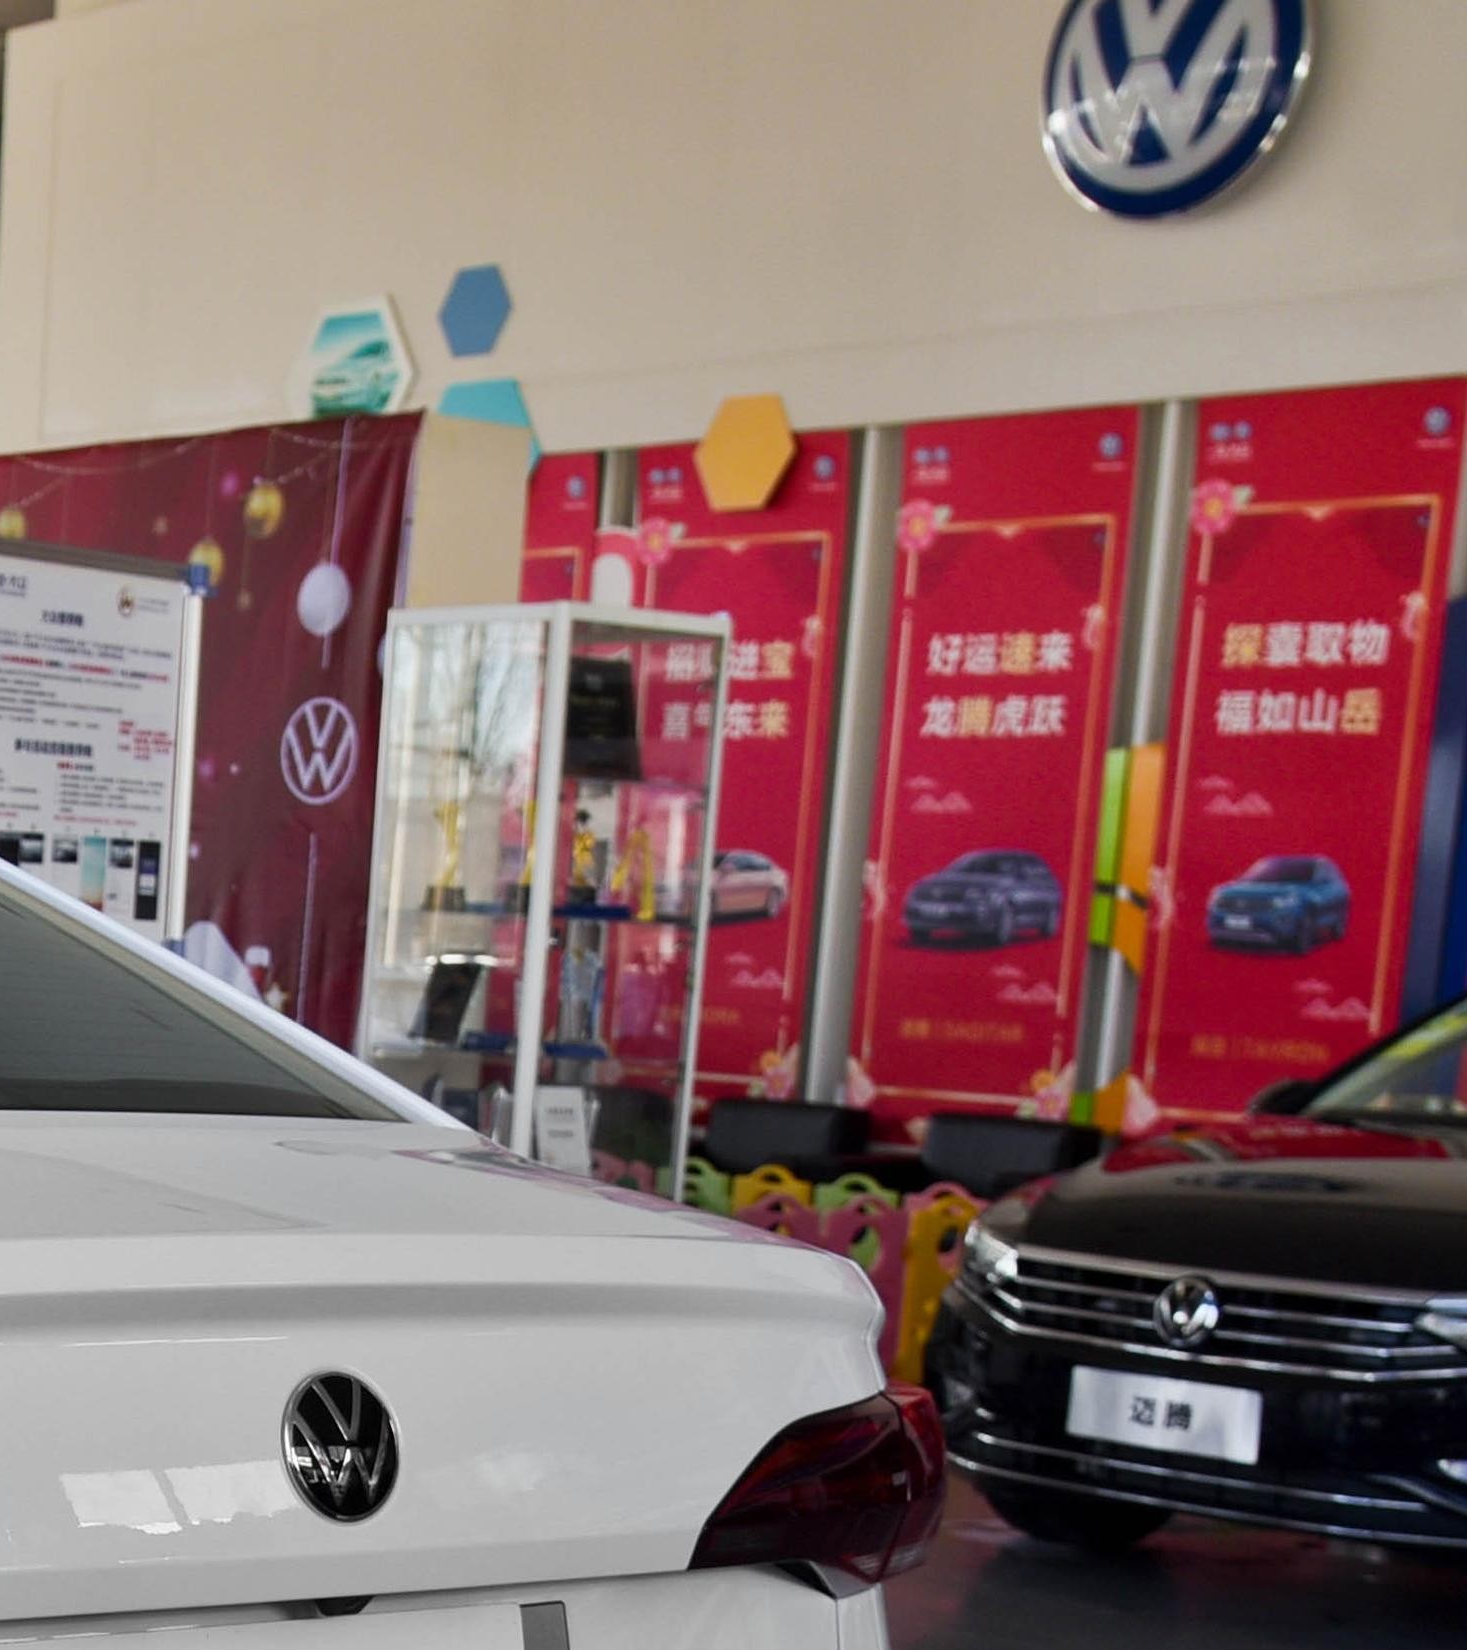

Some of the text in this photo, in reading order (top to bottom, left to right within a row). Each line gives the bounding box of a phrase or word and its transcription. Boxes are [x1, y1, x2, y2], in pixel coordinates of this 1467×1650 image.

[926, 631, 1073, 676] 好运速来
[1221, 619, 1390, 668] 探囊取物
[920, 694, 1065, 738] 龙腾虎跃
[1215, 688, 1381, 736] 福如山岳
